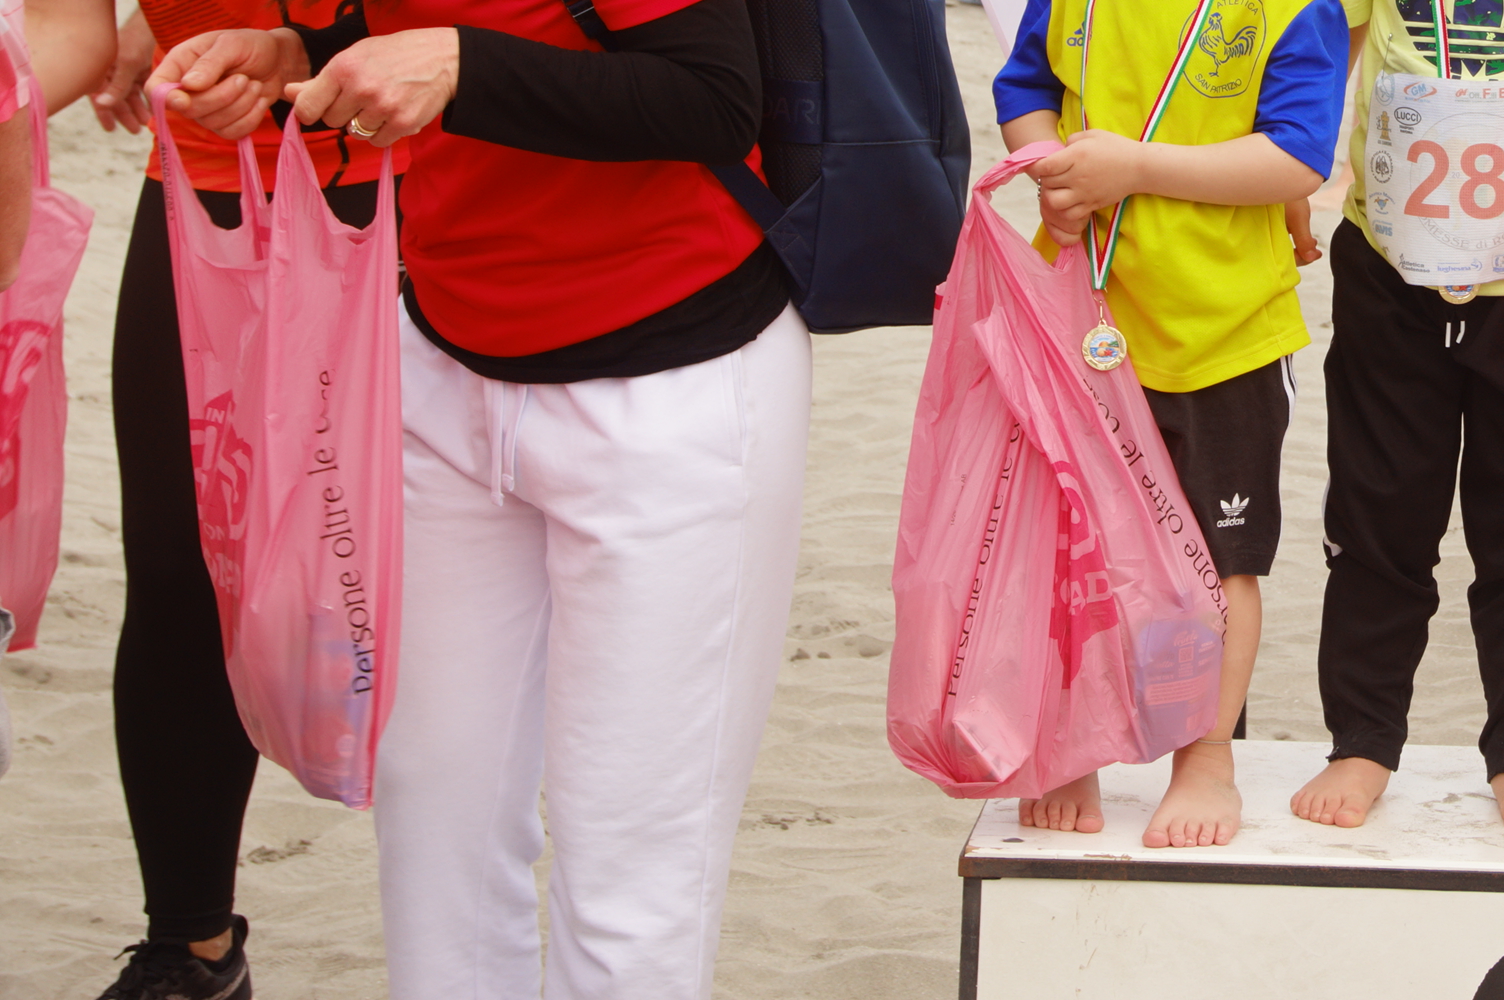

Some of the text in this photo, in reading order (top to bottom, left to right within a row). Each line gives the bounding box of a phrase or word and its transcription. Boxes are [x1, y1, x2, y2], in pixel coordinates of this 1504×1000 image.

[1195, 73, 1210, 91] SAN
[1411, 83, 1427, 96] GM
[1395, 110, 1419, 122] LUCCI
[306, 446, 340, 477] le
[1120, 439, 1144, 468] le
[1141, 470, 1184, 536] oltre
[319, 484, 356, 560] oltre
[1216, 517, 1245, 528] adidas
